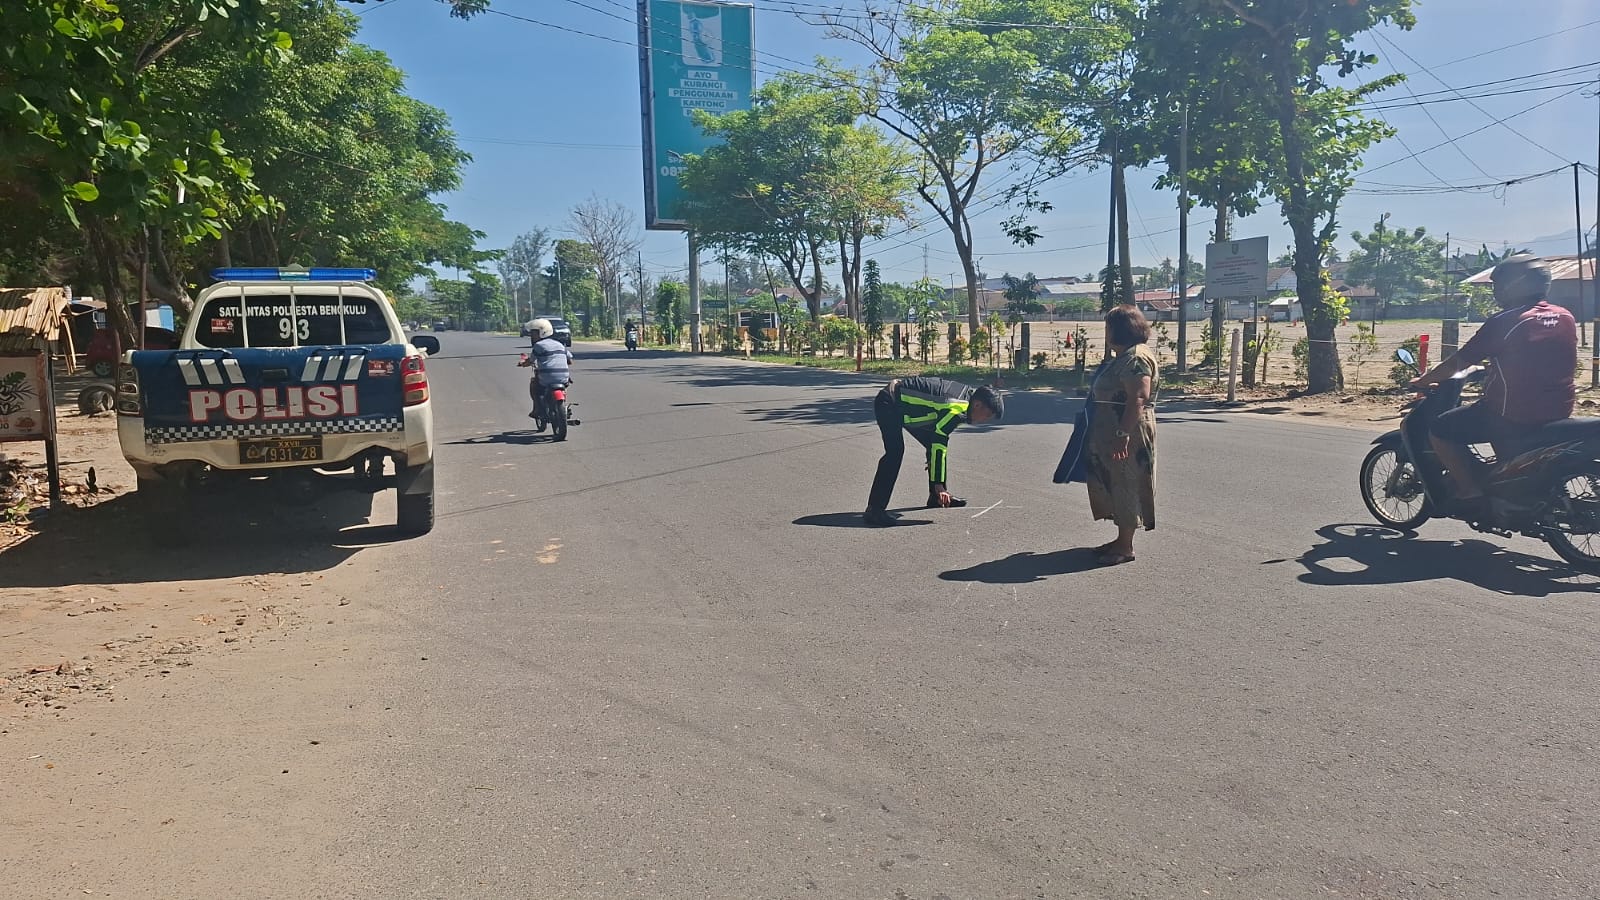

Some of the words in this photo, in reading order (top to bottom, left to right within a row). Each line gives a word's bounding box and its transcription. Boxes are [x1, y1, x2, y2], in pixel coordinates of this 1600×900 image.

[694, 71, 712, 79] AYO
[673, 89, 734, 99] PENGGUNAAN
[683, 99, 725, 108] KANTONG
[686, 109, 722, 117] PTIK
[219, 306, 271, 317] SATLNTAS
[189, 384, 358, 421] POLISI
